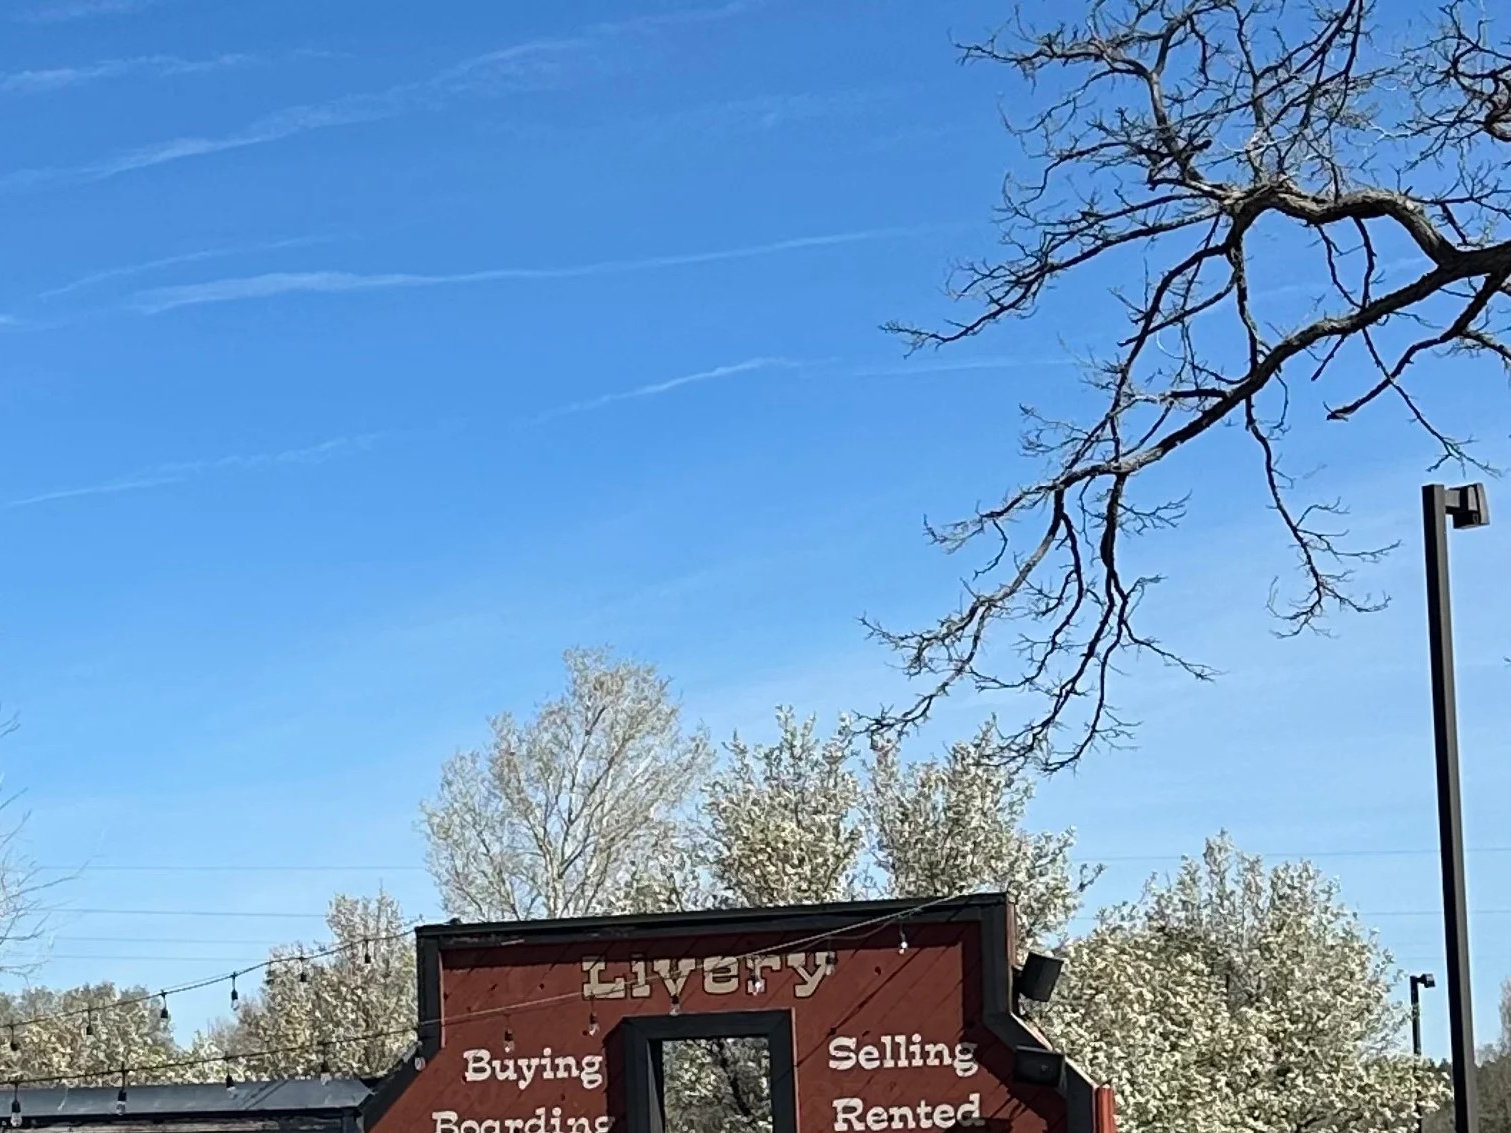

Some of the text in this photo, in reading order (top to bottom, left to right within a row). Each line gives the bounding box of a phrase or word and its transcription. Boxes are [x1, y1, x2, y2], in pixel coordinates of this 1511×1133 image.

[581, 951, 836, 999] Livery
[463, 1047, 603, 1090] Buying
[828, 1033, 979, 1078] Selling
[832, 1093, 986, 1132] Rented
